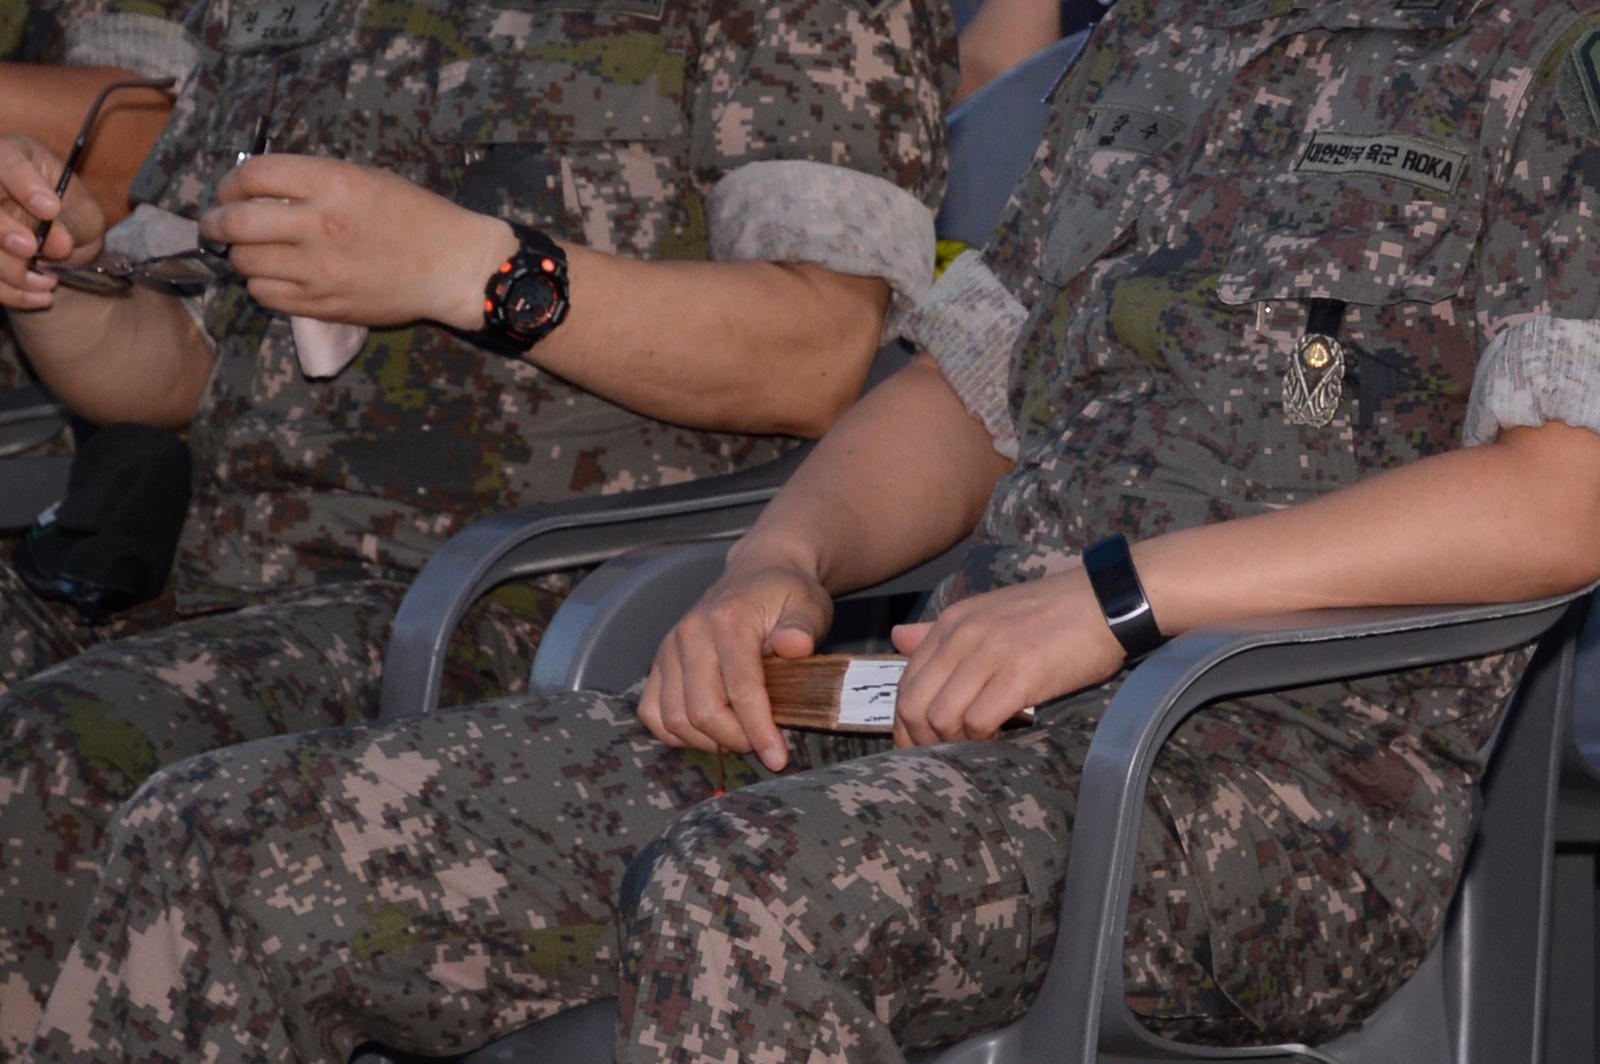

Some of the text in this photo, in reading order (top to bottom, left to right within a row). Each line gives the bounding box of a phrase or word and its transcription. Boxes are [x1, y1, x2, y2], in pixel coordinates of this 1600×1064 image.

[1307, 142, 1454, 182] 대한민국 육군 ROKA
